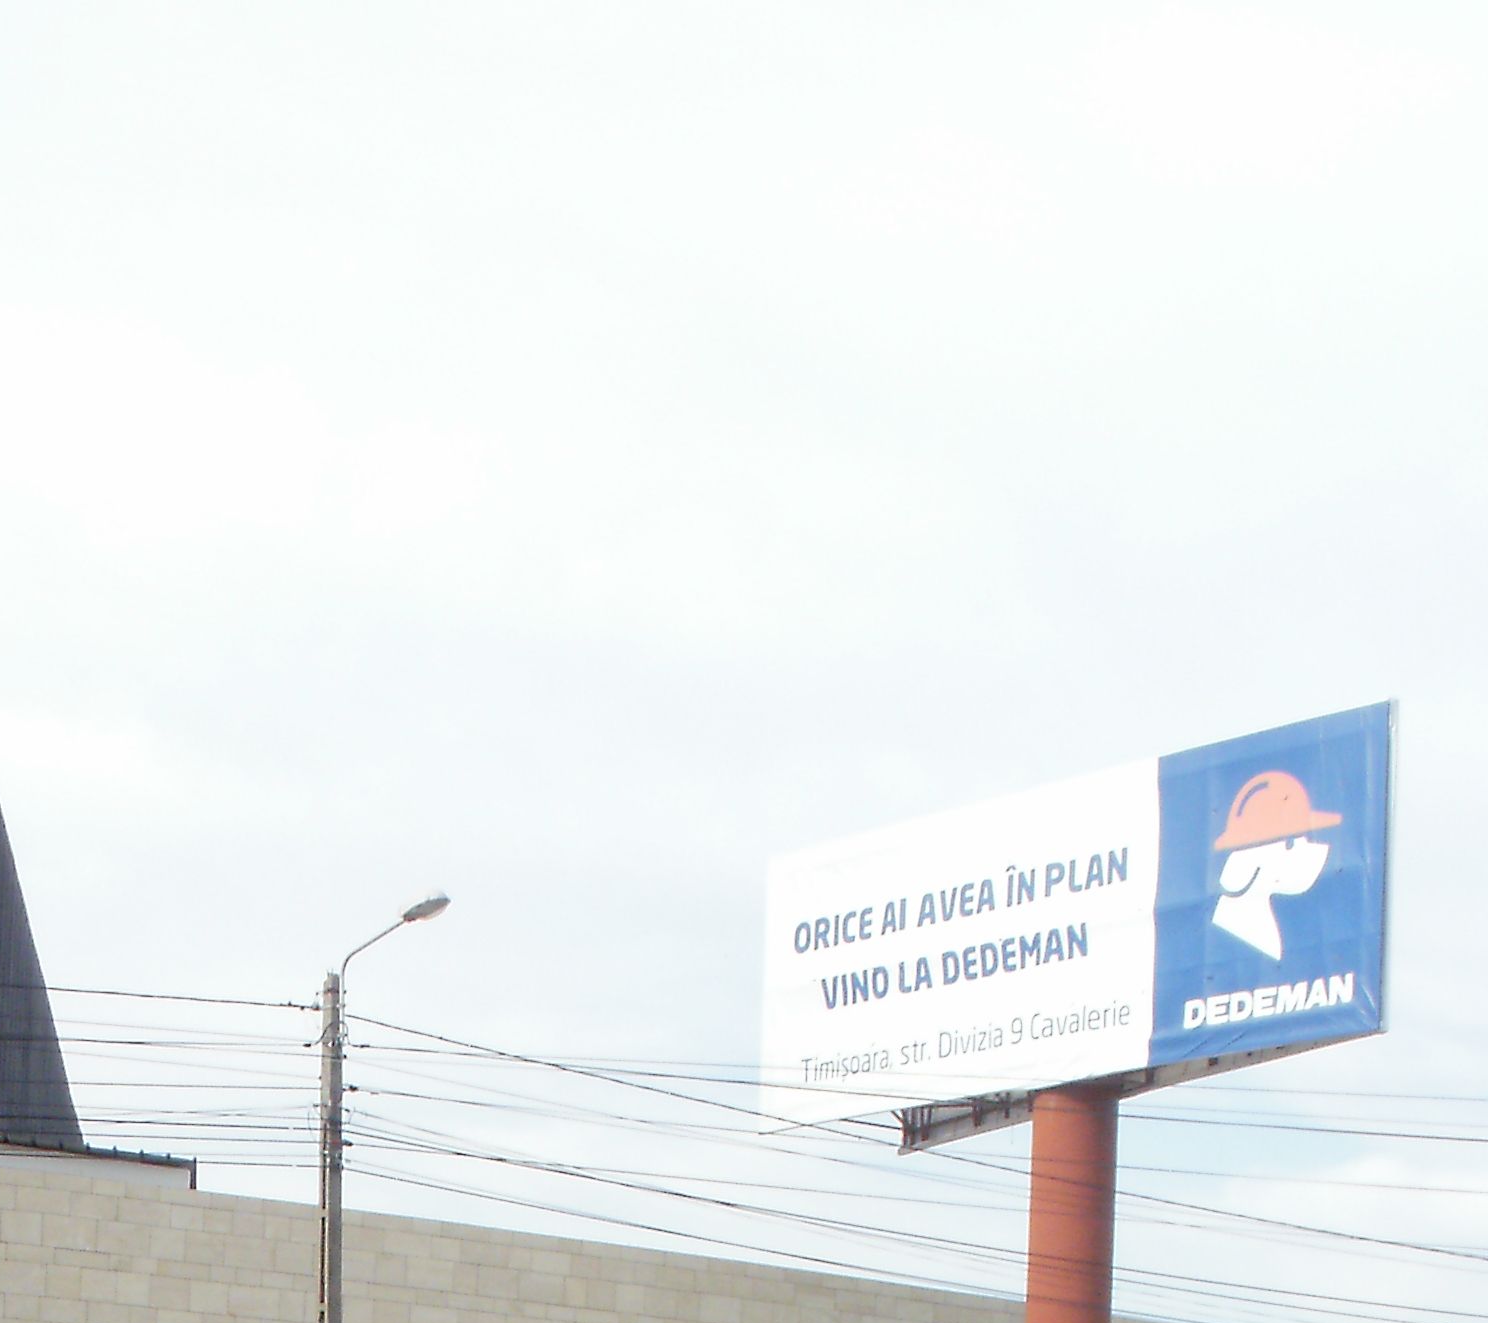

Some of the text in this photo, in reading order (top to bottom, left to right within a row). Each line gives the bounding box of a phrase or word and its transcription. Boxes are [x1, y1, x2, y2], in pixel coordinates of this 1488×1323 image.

[793, 847, 1129, 954] ORICE AI AVEA ÎN PLAN
[820, 922, 1089, 1010] VINO LA DEDEMAN
[1183, 972, 1355, 1029] DEDEMAN
[900, 1039, 932, 1068] str.
[938, 1019, 1004, 1060] Divizia
[1010, 1017, 1025, 1045] 9
[1030, 1001, 1131, 1041] Cavalerie
